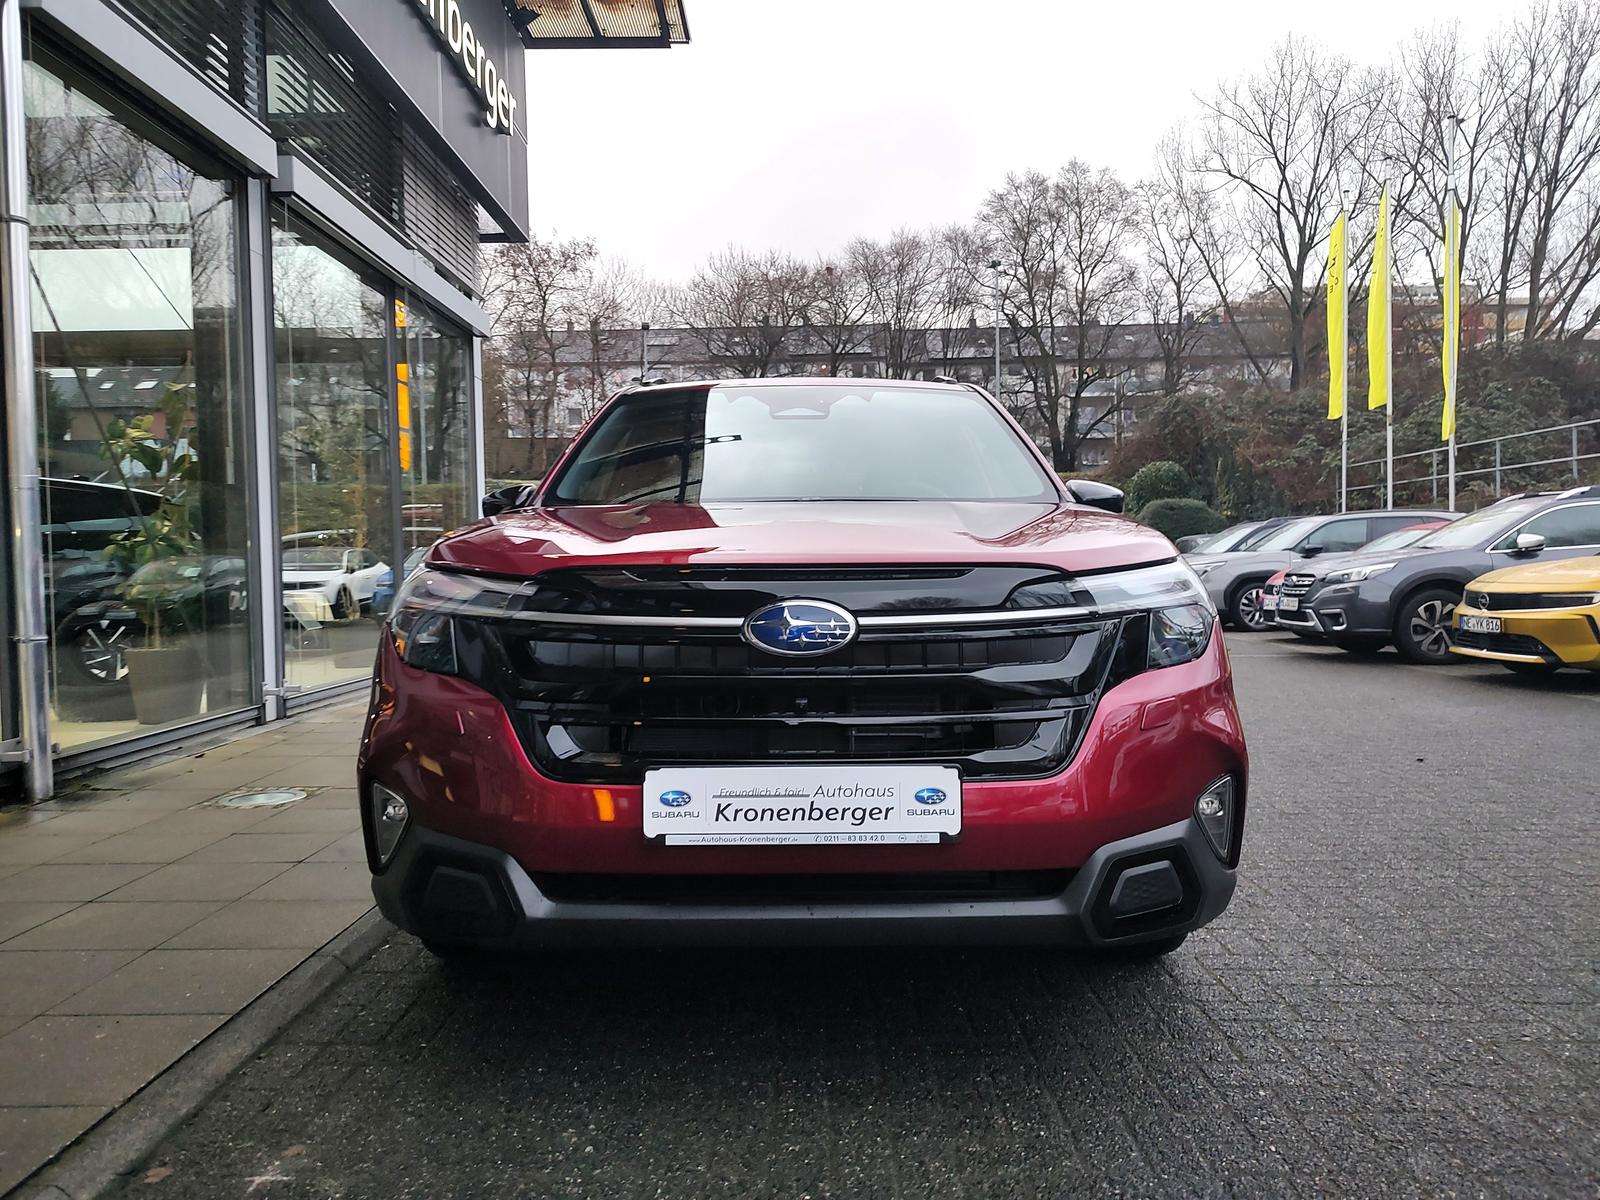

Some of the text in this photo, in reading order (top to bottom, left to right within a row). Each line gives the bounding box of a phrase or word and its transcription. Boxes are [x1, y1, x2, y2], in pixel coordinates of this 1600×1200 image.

[719, 787, 771, 798] Freundlich
[784, 787, 805, 798] fair!
[813, 782, 894, 798] Autohaus
[651, 811, 700, 819] SUBARU
[715, 801, 895, 826] Kronenberger
[906, 808, 956, 816] SUBARU
